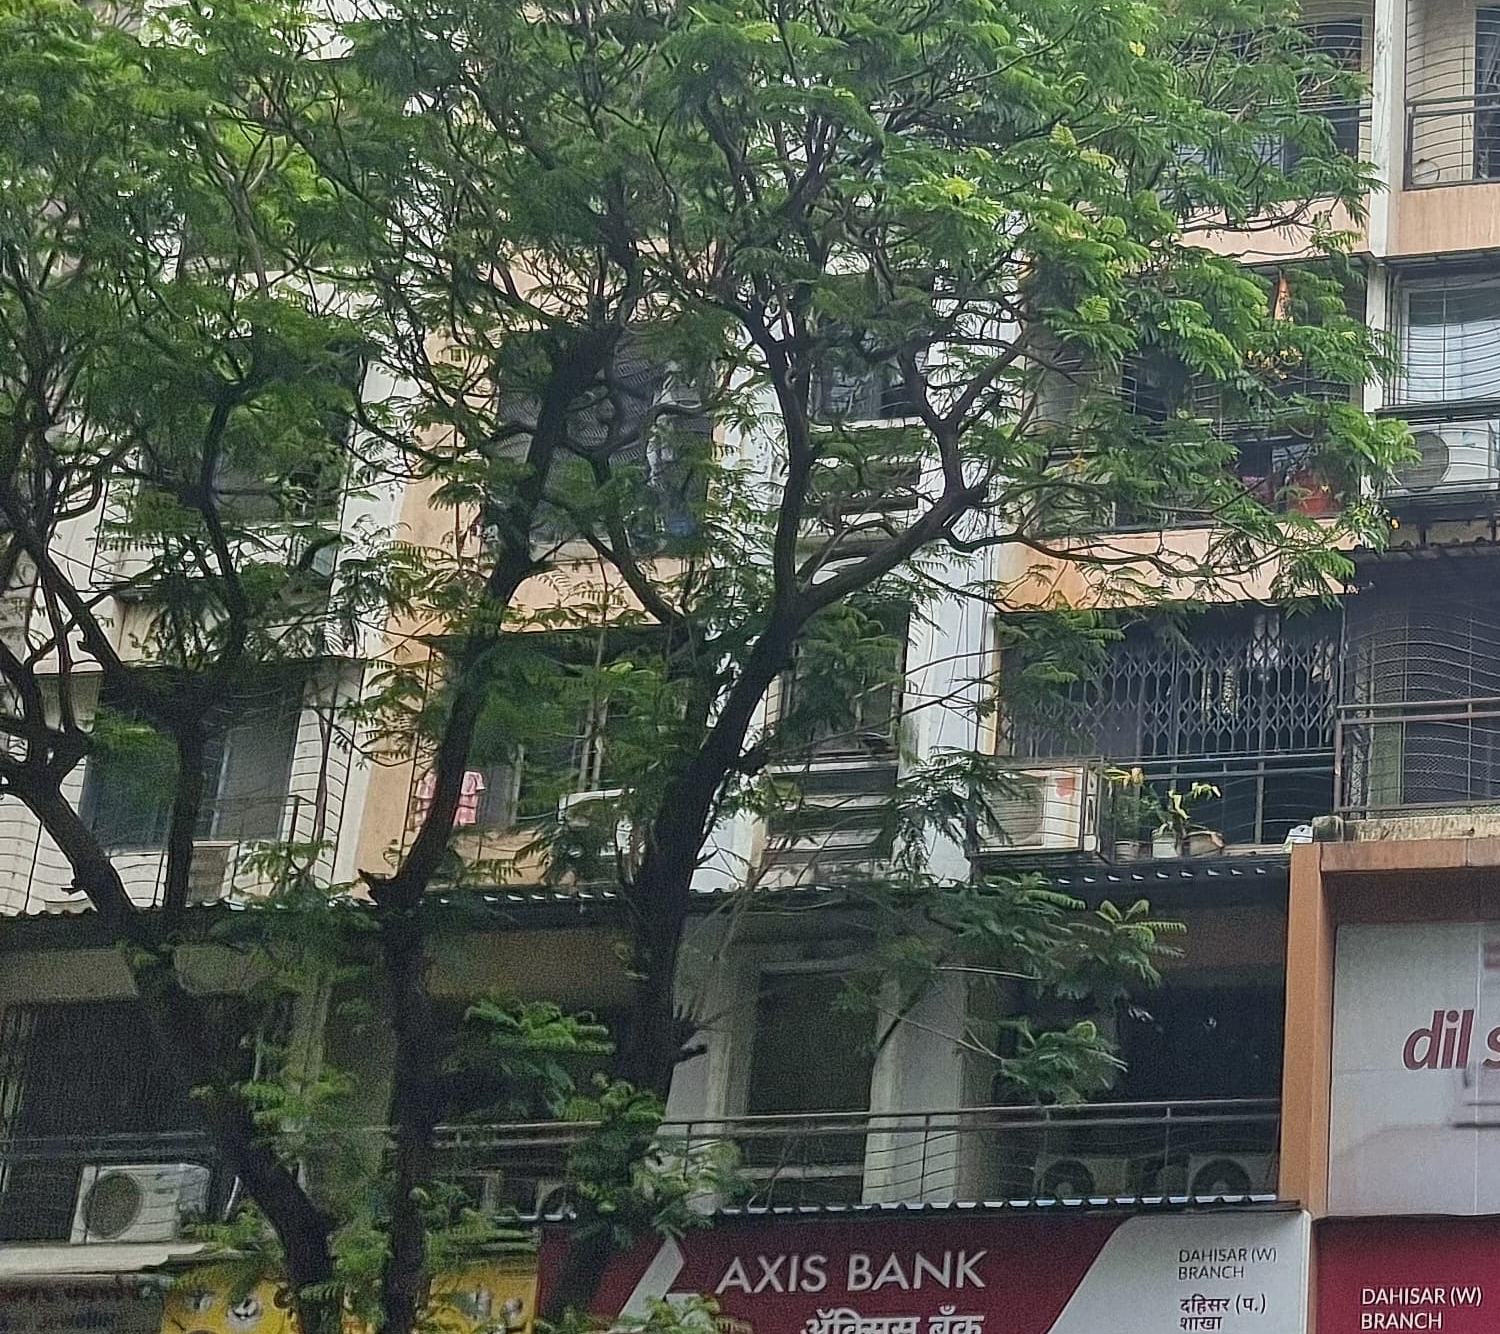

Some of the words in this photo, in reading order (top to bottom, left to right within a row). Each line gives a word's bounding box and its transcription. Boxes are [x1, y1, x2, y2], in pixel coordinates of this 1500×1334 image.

[1403, 1010, 1476, 1070] dil
[1179, 1248, 1247, 1263] DAHISAR
[1251, 1247, 1277, 1263] (W)
[715, 1254, 829, 1294] AXIS
[847, 1250, 988, 1289] BANK
[1178, 1266, 1245, 1280] BRANCH
[1180, 1293, 1230, 1315] दहिसर
[1236, 1294, 1266, 1315] (प.)
[1361, 1286, 1445, 1306] DAHISAR
[1449, 1285, 1482, 1308] (W)
[1180, 1317, 1222, 1331] शाखा
[1361, 1311, 1443, 1331] BRANCH
